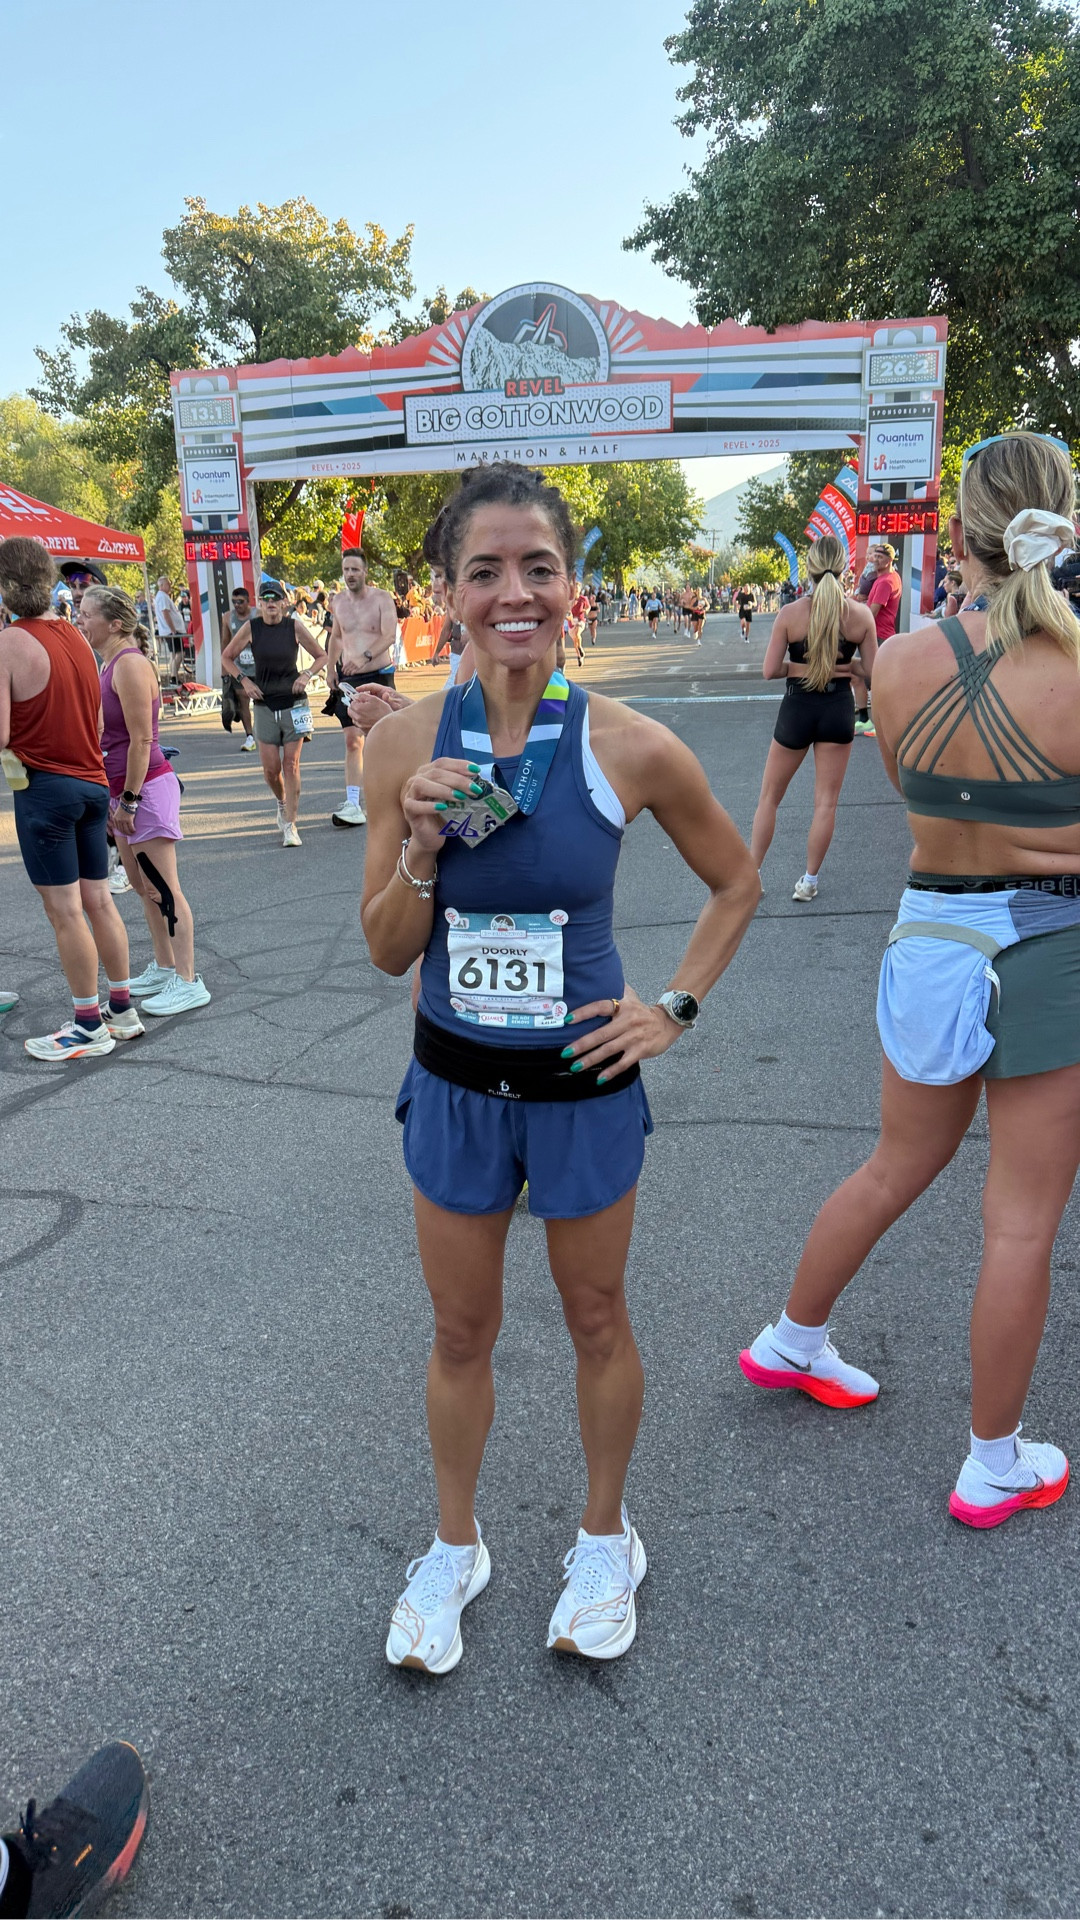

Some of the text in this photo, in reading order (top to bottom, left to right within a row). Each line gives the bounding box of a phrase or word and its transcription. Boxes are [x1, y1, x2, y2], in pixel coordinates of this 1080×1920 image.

[880, 359, 929, 377] 26.2
[506, 378, 564, 396] REVEL
[190, 406, 223, 421] 13.1
[416, 396, 664, 433] BIG COTTONWOOD
[872, 408, 917, 417] SPONSORED
[723, 439, 780, 449] REVEL 2025
[877, 433, 924, 445] Quantum
[457, 444, 619, 462] MARATHON & HALF
[341, 462, 361, 470] 2025
[192, 471, 231, 481] Quantum
[834, 501, 855, 532] REVEL
[828, 511, 847, 539] REVEL
[46, 537, 80, 550] REVEL
[514, 759, 533, 804] RATHON
[482, 947, 528, 956] DOORLY
[458, 957, 546, 992] 6131
